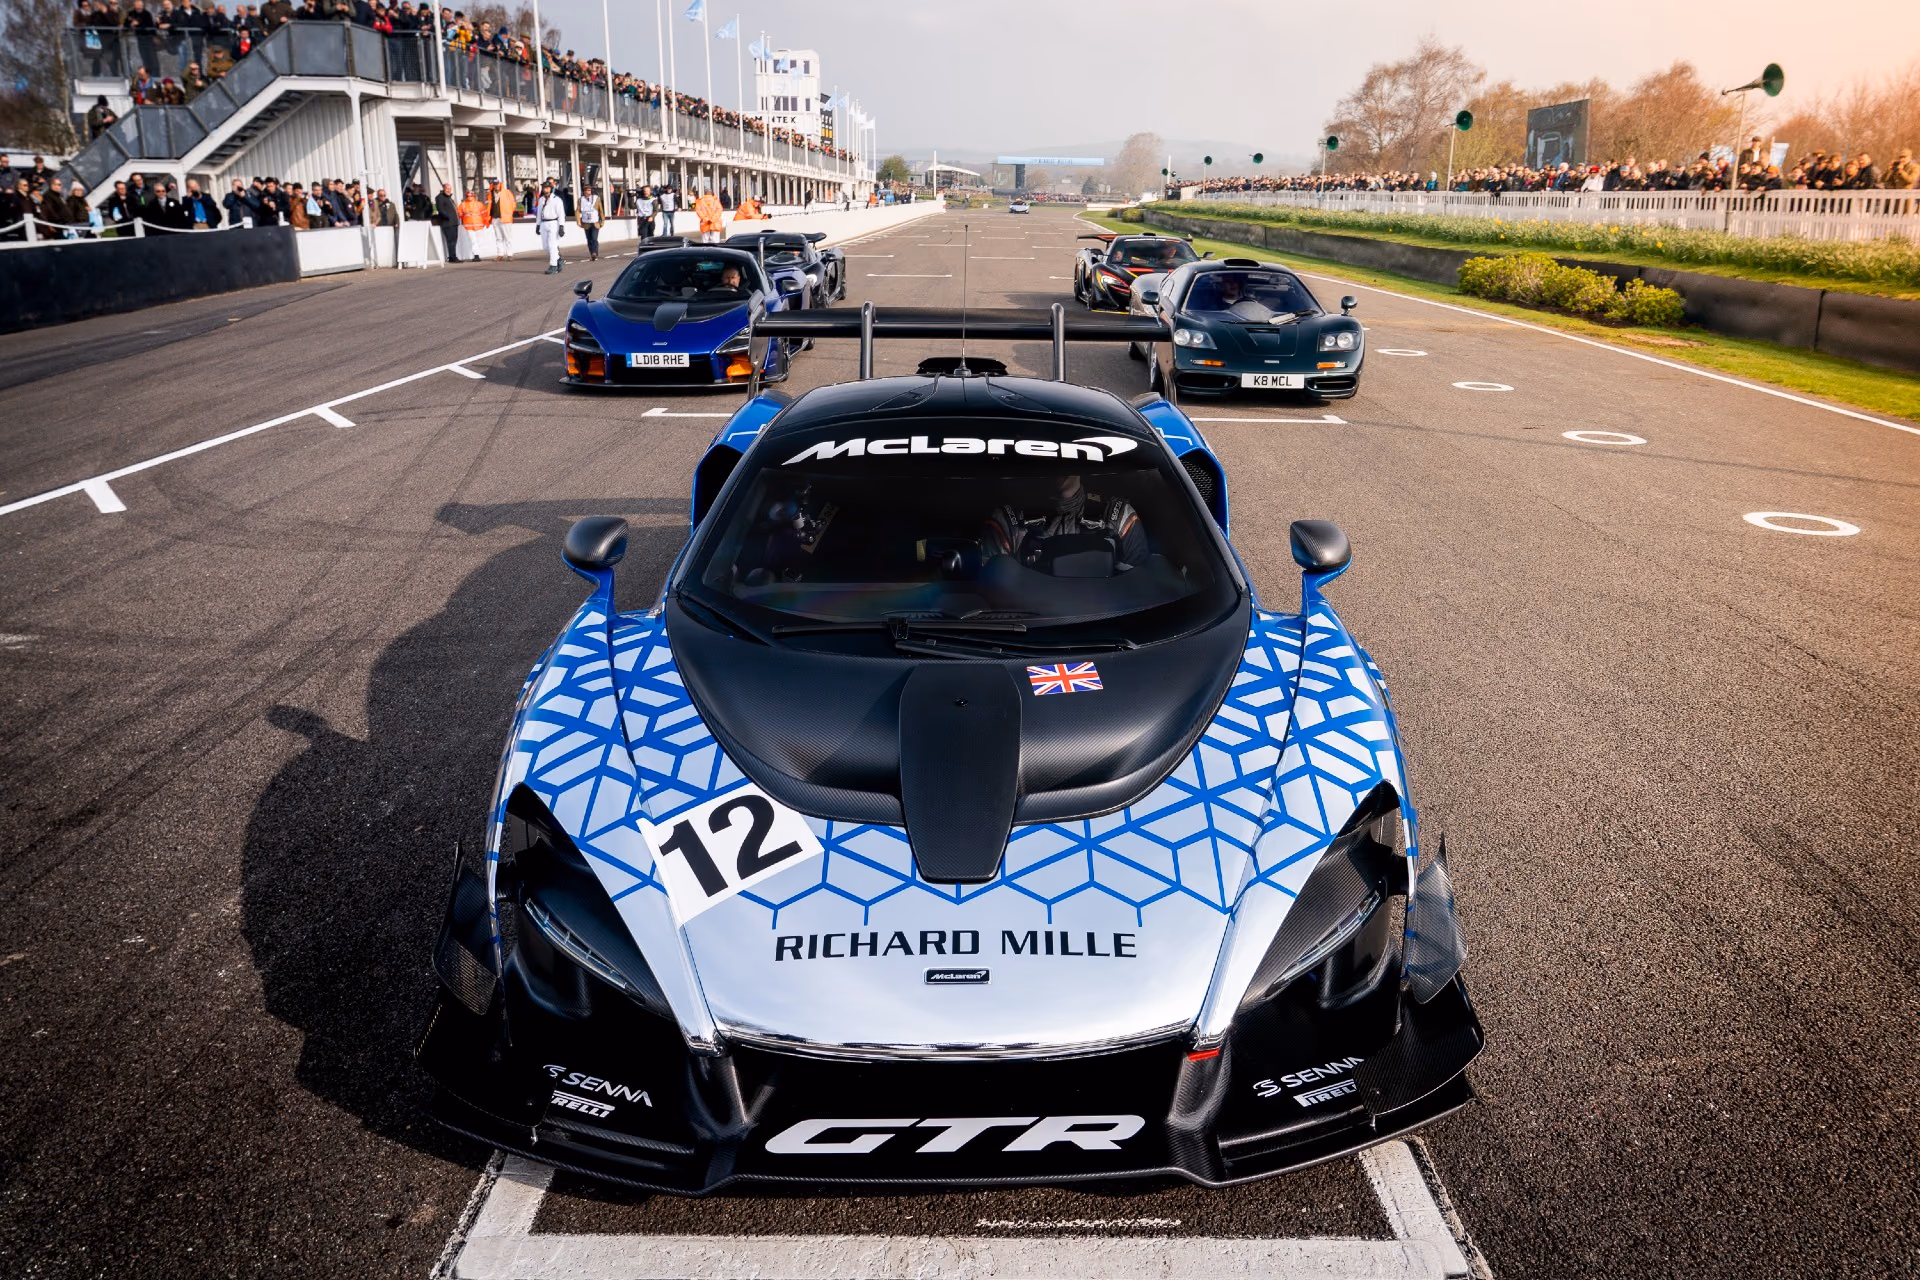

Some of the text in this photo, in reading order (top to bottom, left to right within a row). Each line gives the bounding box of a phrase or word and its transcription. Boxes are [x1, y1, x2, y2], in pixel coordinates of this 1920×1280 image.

[540, 120, 547, 129] 2
[579, 127, 585, 137] 3
[610, 134, 616, 142] 4
[638, 139, 643, 147] 5
[635, 354, 684, 365] LD18 RHE
[1253, 376, 1292, 386] K8 MCL
[781, 436, 1138, 466] McLaren
[658, 794, 803, 898] 12
[775, 929, 1138, 961] RICHARD MILLE
[930, 970, 987, 980] McLaren
[1280, 1057, 1364, 1088] SENNA
[562, 1073, 653, 1107] SENNA
[765, 1115, 1146, 1154] GTR
